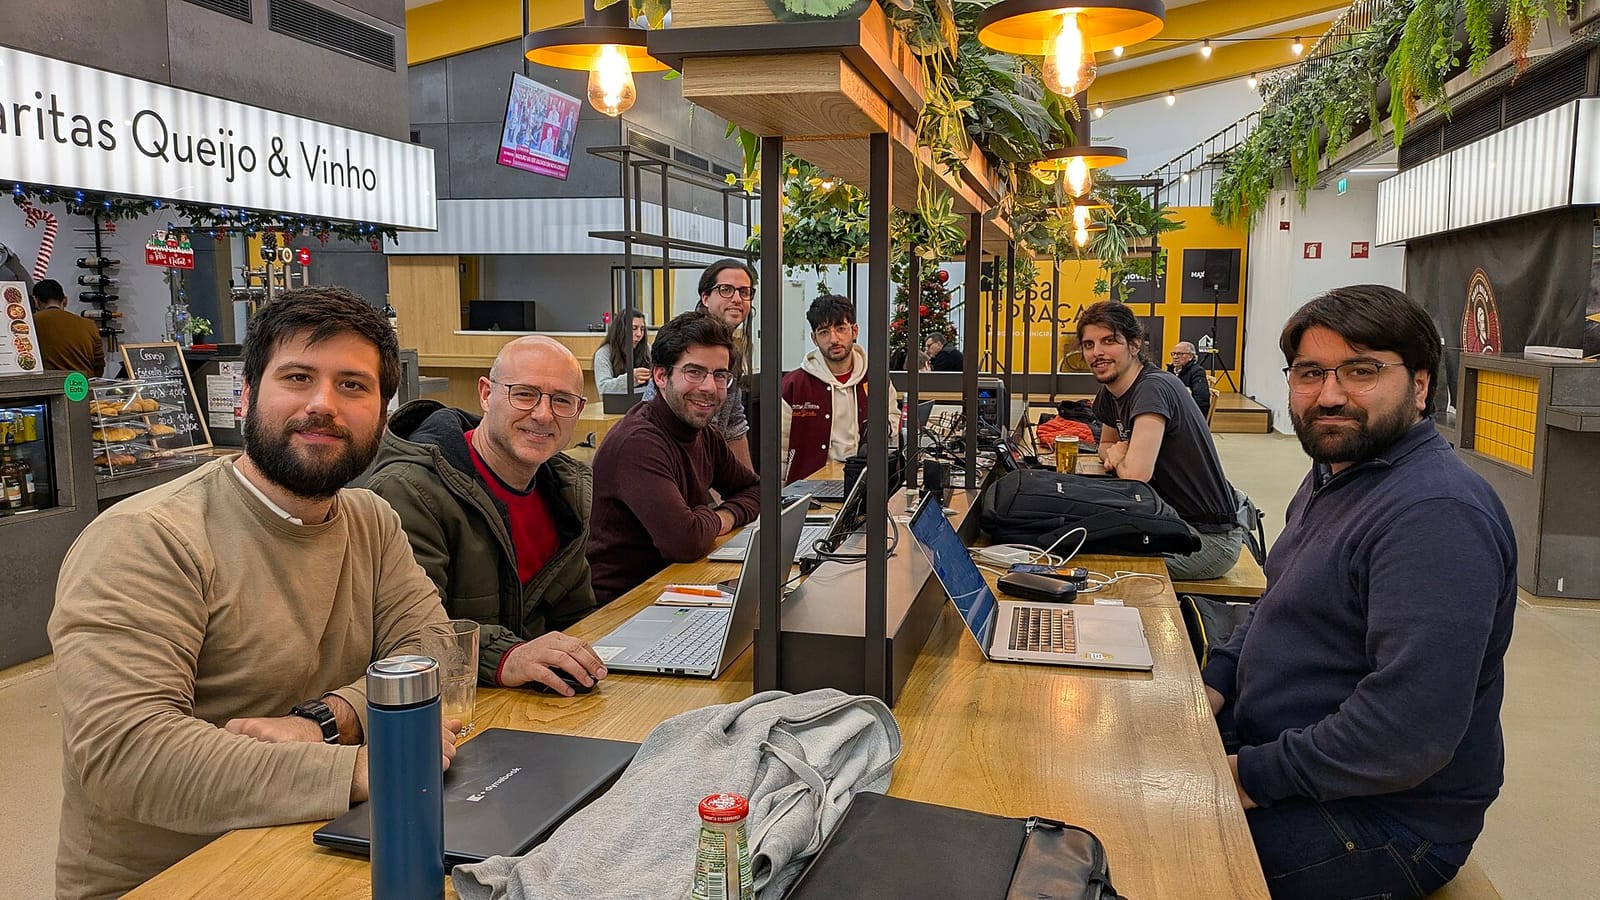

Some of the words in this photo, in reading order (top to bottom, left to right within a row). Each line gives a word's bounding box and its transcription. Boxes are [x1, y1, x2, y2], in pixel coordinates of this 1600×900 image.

[132, 109, 257, 183] Queijo
[268, 136, 291, 179] &
[300, 140, 376, 192] Vinho
